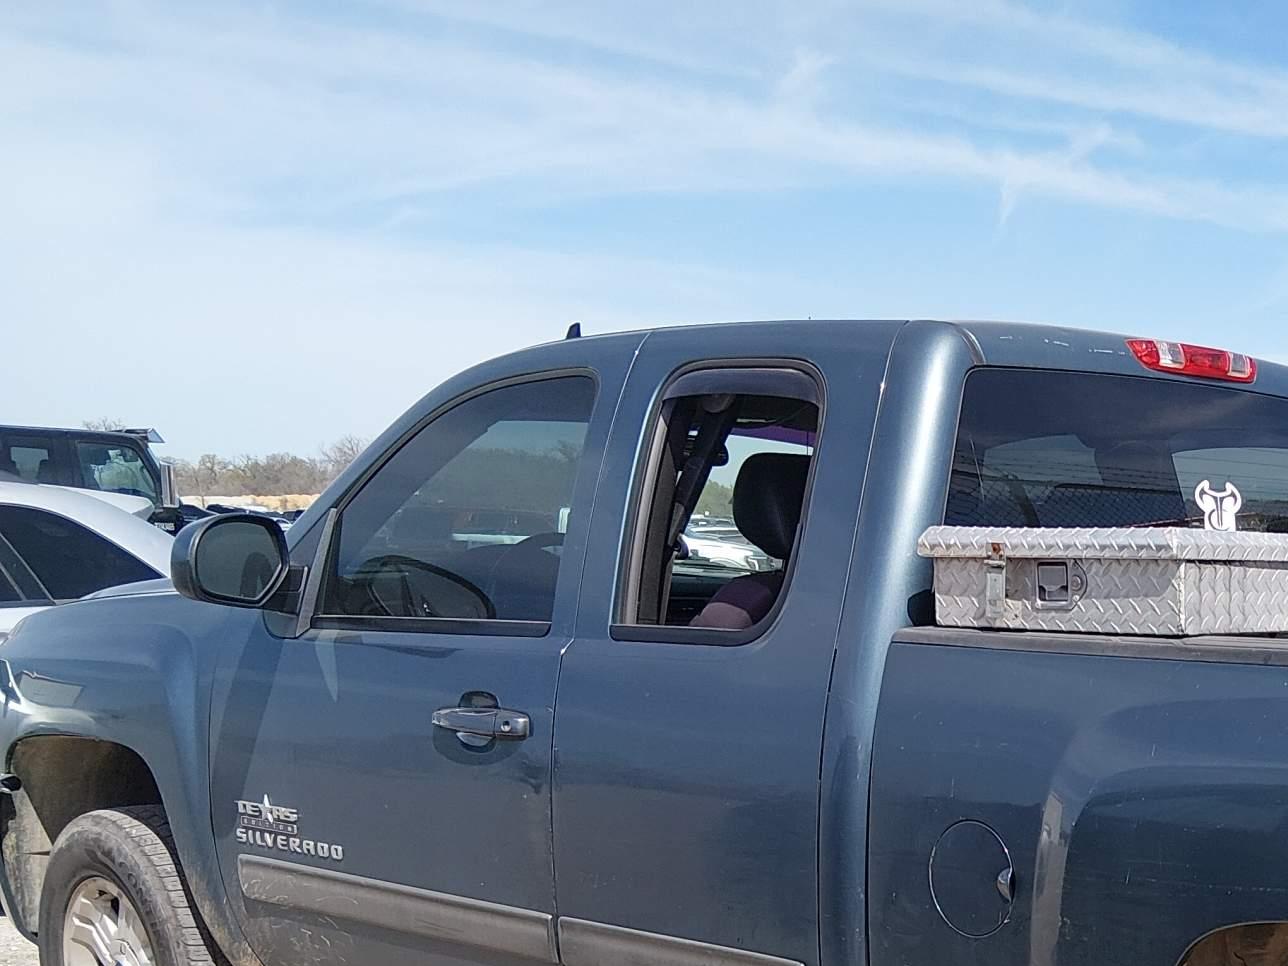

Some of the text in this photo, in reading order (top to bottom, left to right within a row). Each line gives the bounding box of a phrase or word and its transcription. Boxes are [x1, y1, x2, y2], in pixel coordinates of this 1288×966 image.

[234, 794, 298, 823] TEXAS
[242, 817, 294, 833] EDITION
[236, 828, 344, 860] SILVERADO
